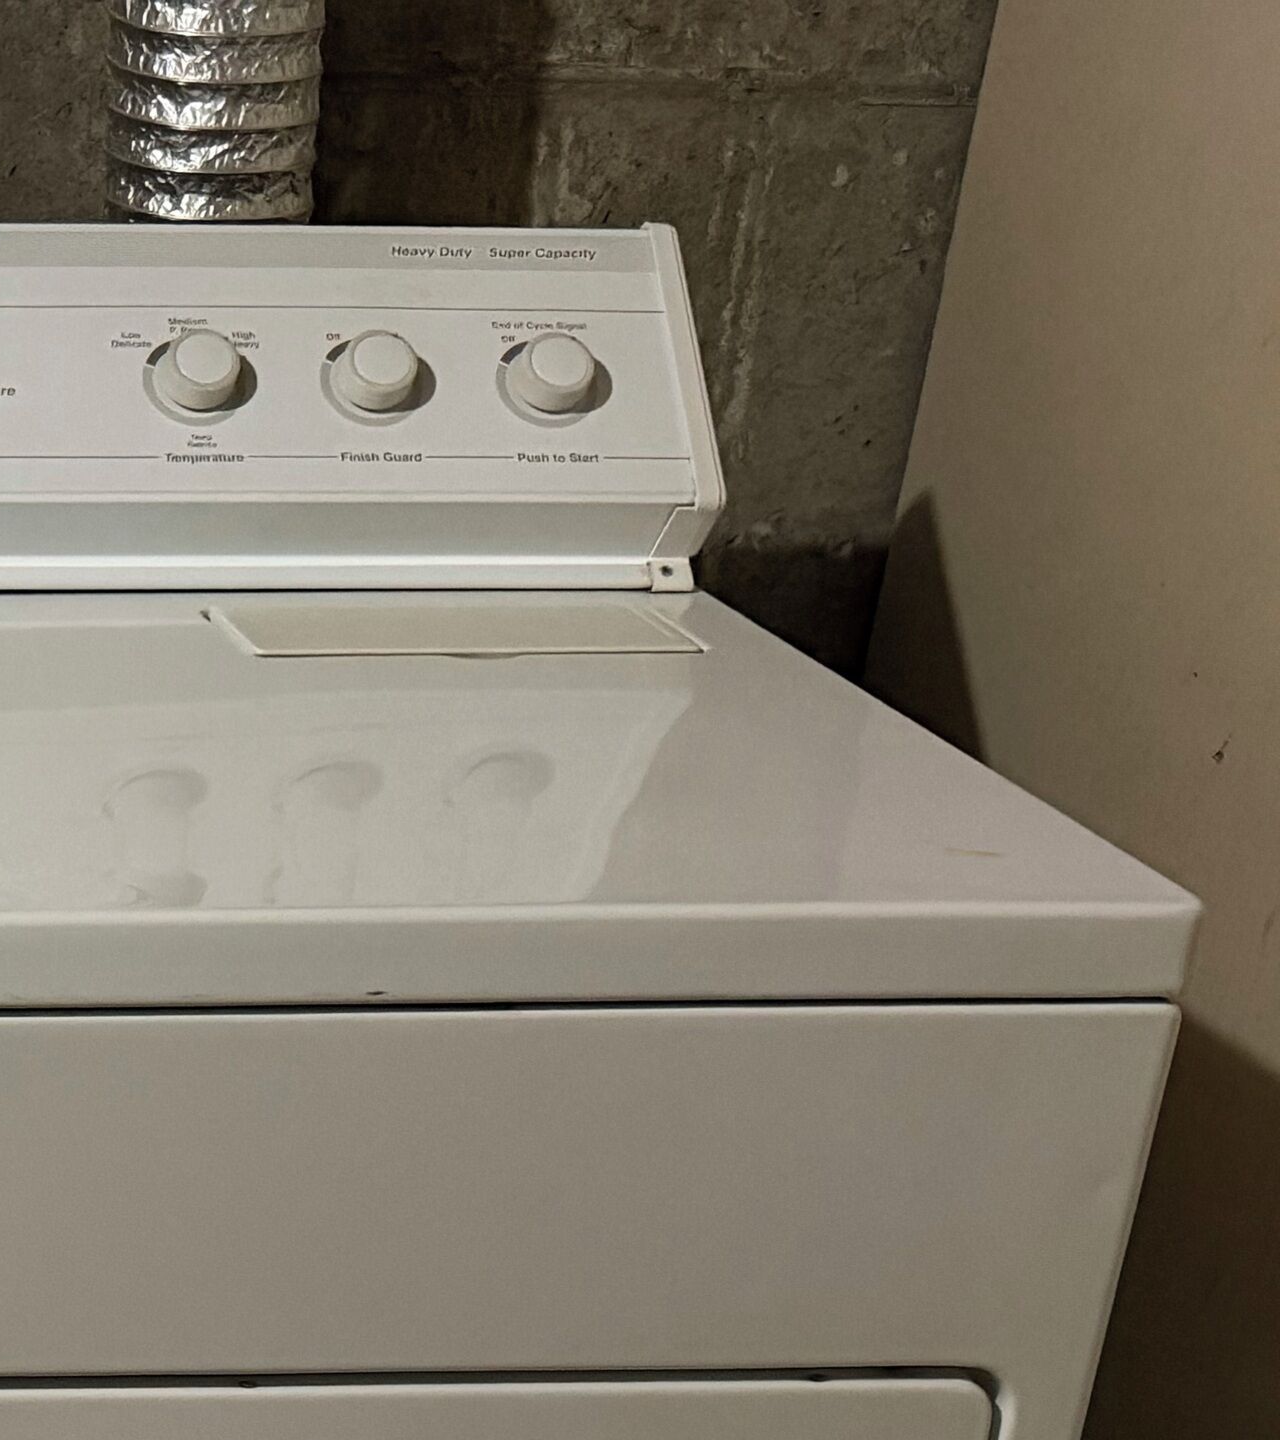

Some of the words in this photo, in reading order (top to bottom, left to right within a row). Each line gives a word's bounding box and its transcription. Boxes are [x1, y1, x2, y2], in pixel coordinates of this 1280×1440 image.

[391, 246, 434, 258] Heavy
[439, 247, 472, 259] Duty
[489, 247, 532, 260] Super
[535, 248, 596, 260] Capacity
[232, 331, 256, 341] High
[340, 451, 380, 463] Finish
[383, 451, 423, 463] Guard
[517, 453, 549, 464] Push
[553, 453, 566, 464] to
[569, 453, 599, 464] Start
